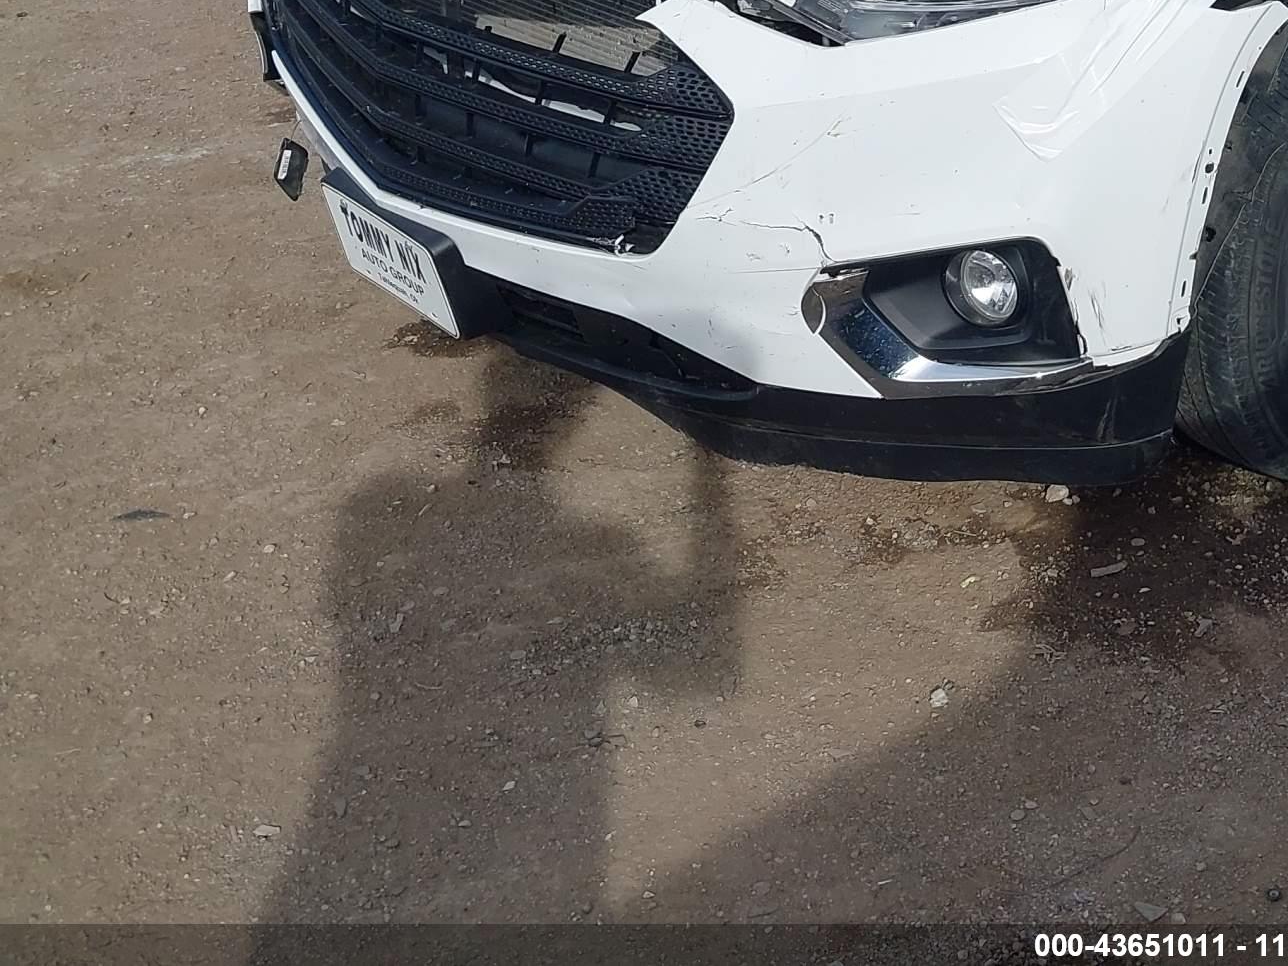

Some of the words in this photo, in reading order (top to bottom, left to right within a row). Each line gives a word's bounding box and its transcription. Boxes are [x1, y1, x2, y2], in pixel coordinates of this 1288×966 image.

[339, 203, 395, 263] TOMMY
[394, 240, 427, 284] NIX
[361, 247, 389, 274] AUTO
[390, 267, 426, 296] GROUP
